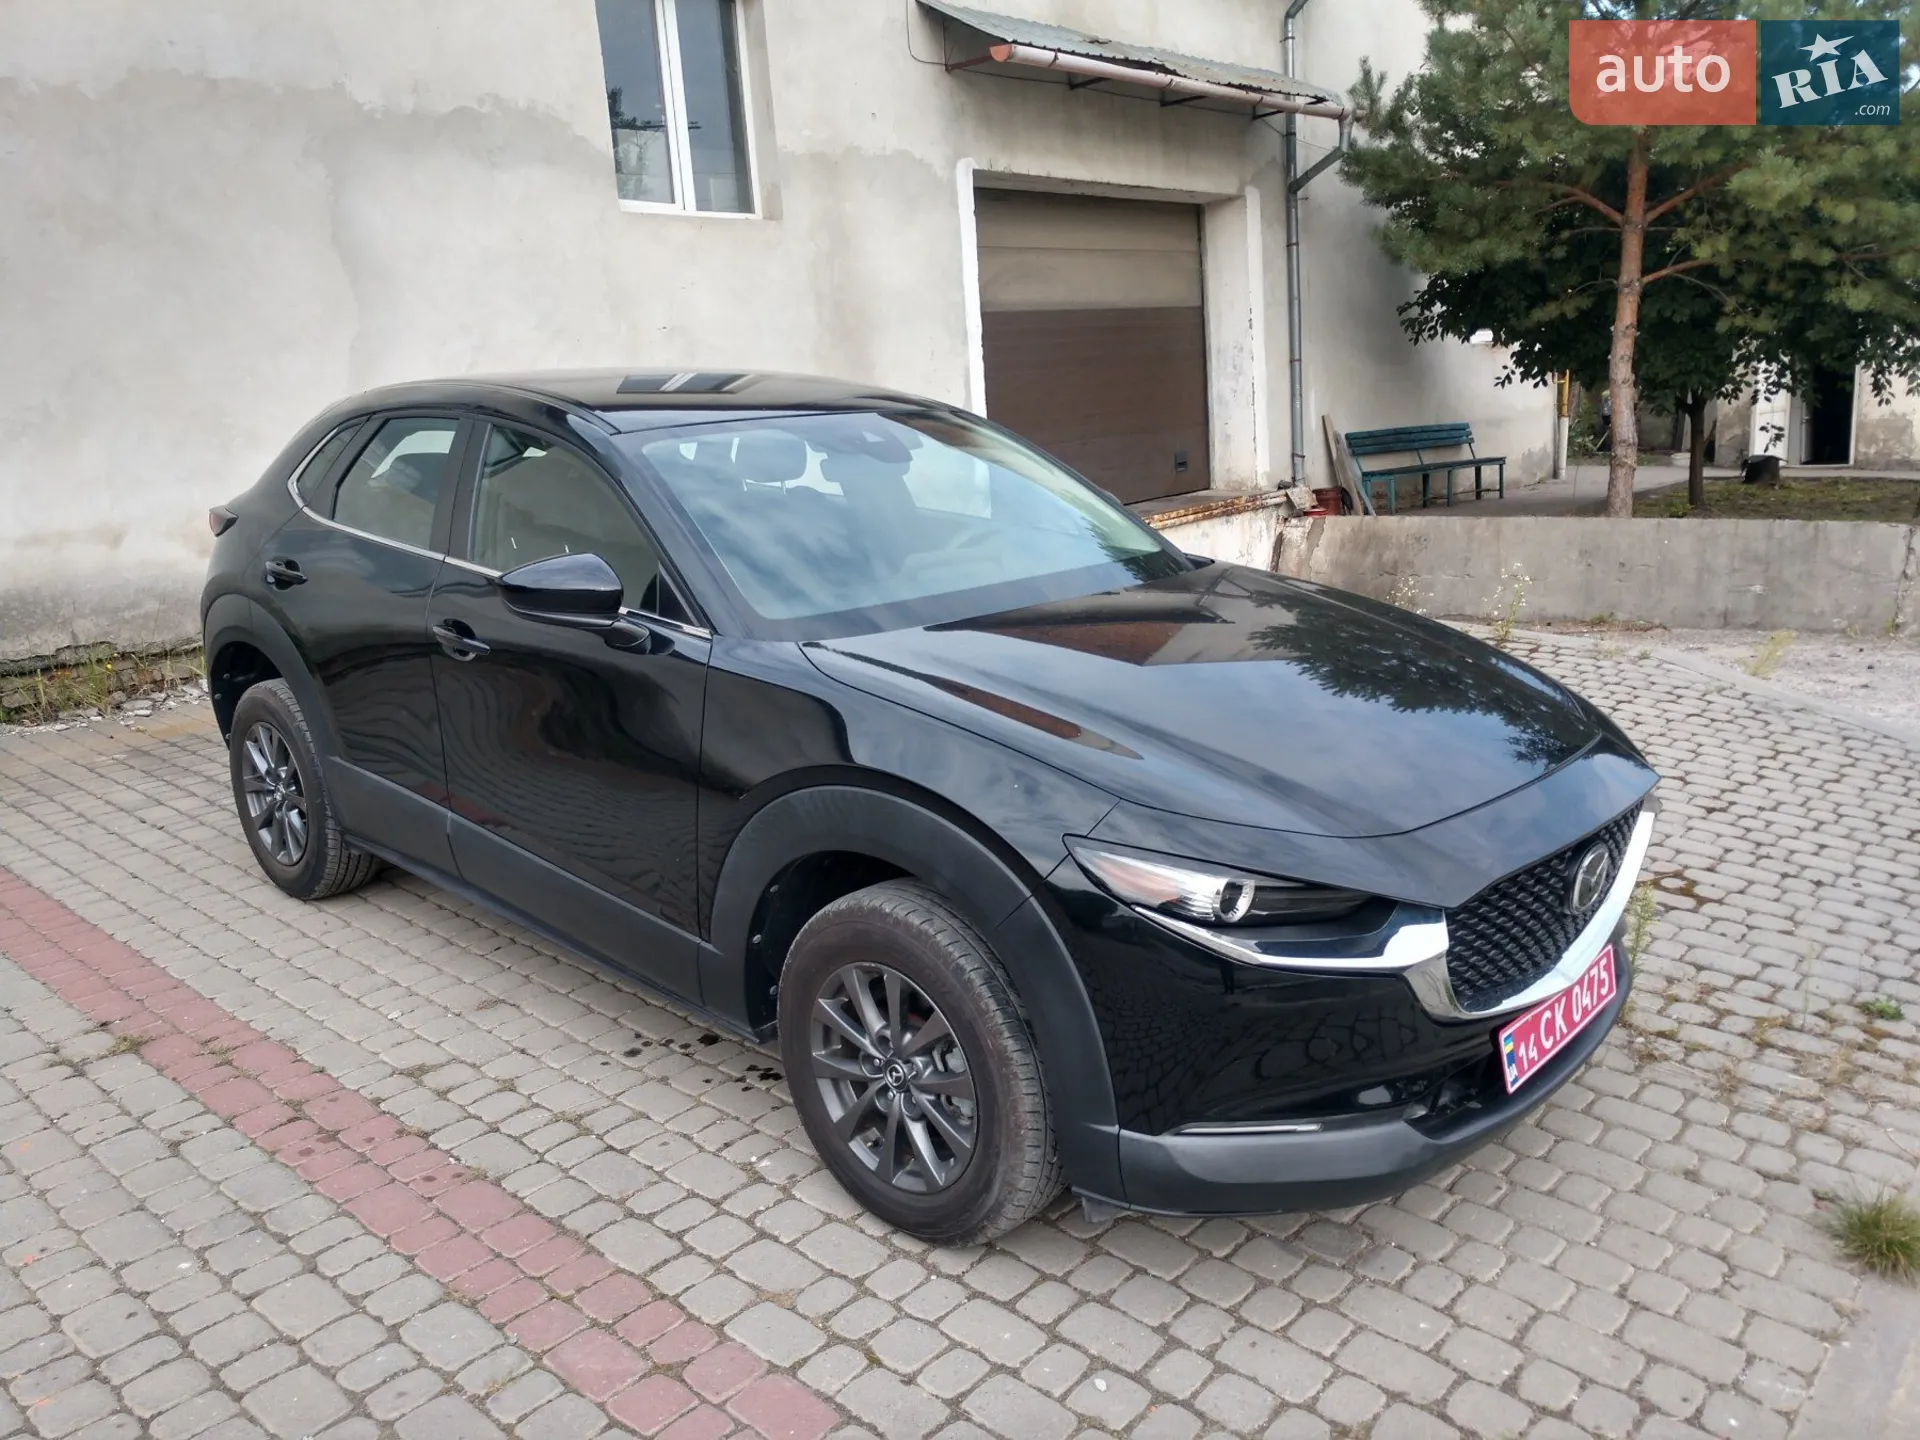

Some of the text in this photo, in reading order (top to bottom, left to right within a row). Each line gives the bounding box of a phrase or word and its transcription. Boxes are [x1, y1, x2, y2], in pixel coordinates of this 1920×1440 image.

[1519, 957, 1608, 1070] 14 CK 0475
